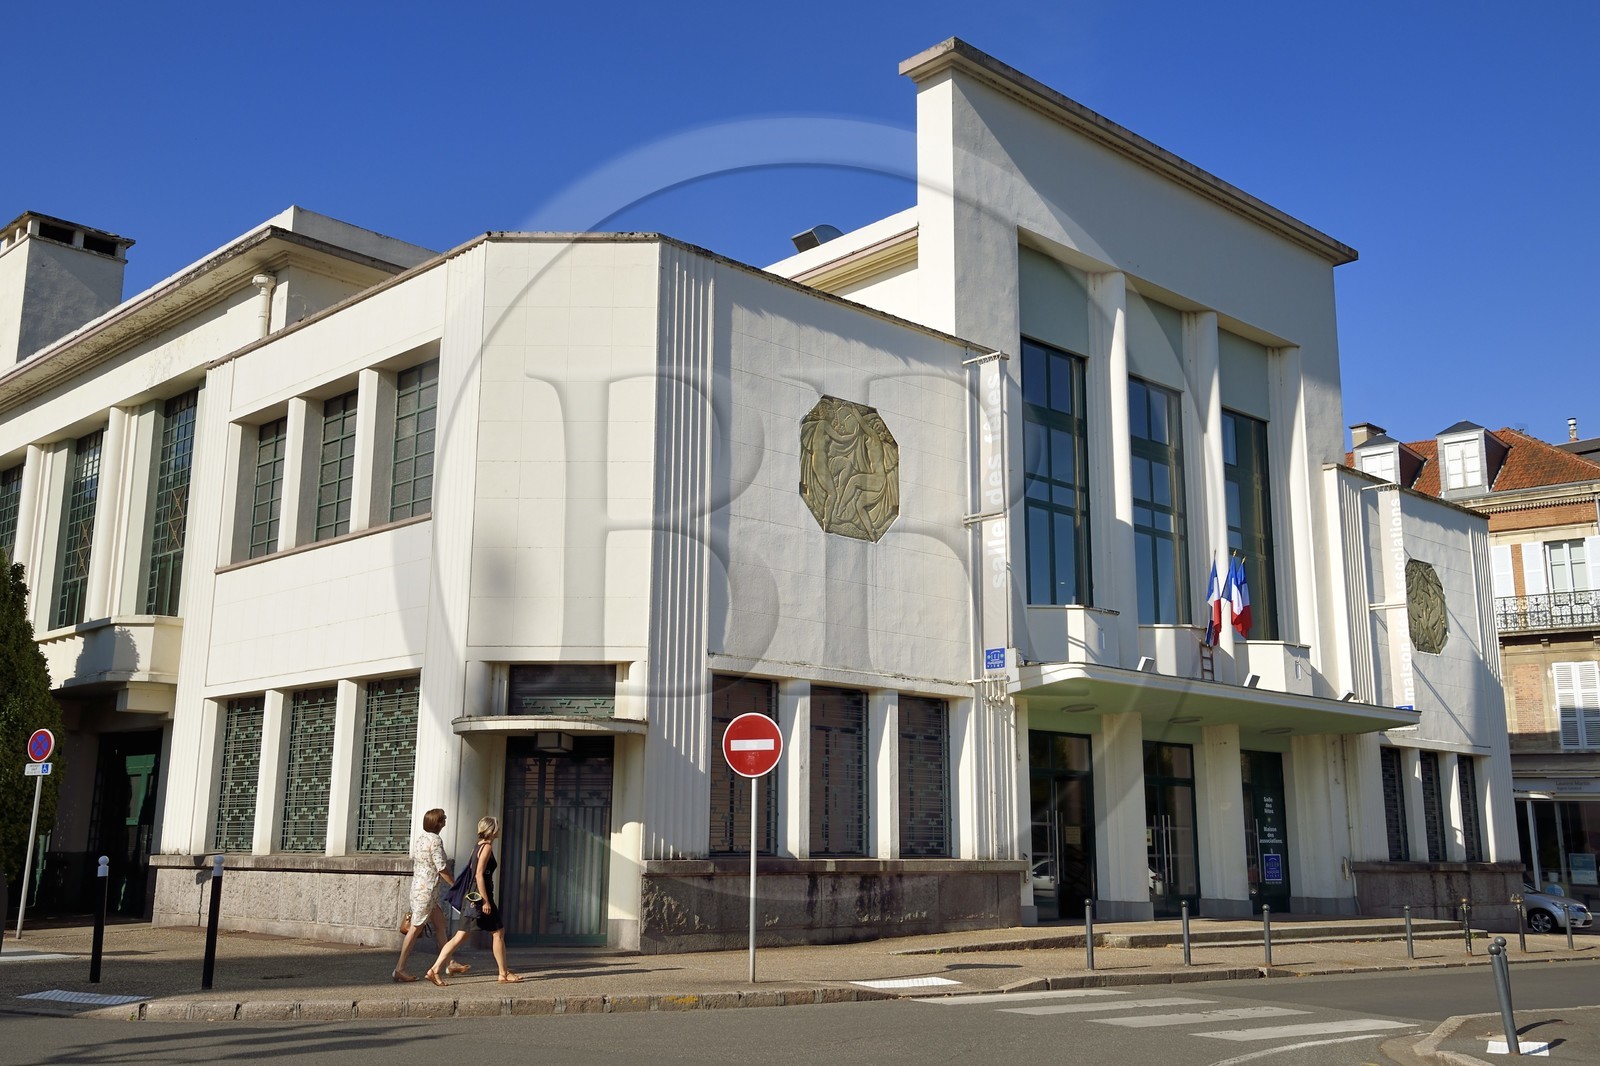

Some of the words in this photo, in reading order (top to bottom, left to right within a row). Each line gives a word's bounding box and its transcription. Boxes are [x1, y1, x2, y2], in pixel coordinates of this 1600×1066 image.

[984, 373, 1001, 445] fêtes
[986, 454, 1003, 506] des
[988, 520, 1006, 588] salle
[1391, 498, 1404, 600] associations
[1399, 606, 1409, 639] des
[1400, 642, 1414, 702] maison
